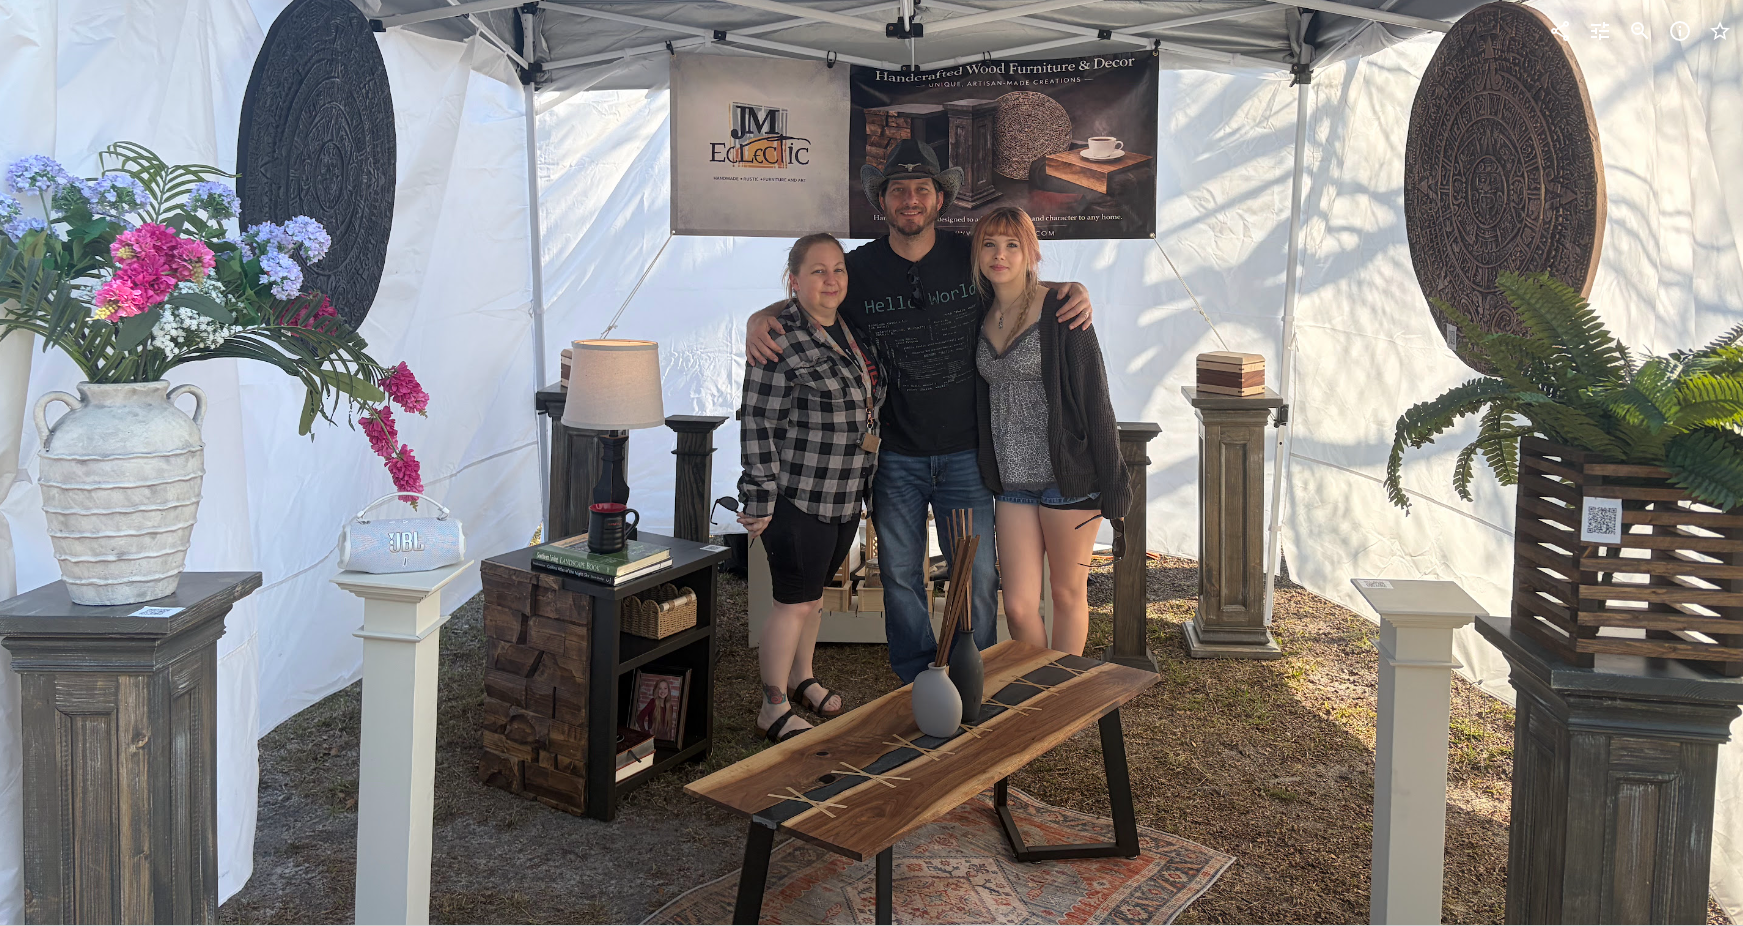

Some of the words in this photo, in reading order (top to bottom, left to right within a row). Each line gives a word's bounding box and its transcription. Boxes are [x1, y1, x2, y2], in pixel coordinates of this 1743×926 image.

[875, 67, 963, 83] Handcrafted
[966, 62, 1005, 75] Wood
[1009, 62, 1076, 75] Furniture
[1078, 60, 1091, 71] &
[1093, 57, 1135, 70] Decor
[966, 79, 1030, 87] ARTISAN-MADE
[1032, 77, 1081, 86] CREATIONS
[730, 105, 780, 139] JM
[1045, 214, 1077, 222] character
[927, 283, 977, 306] World
[388, 531, 425, 554] JBL
[559, 557, 586, 569] LANDSCAPE
